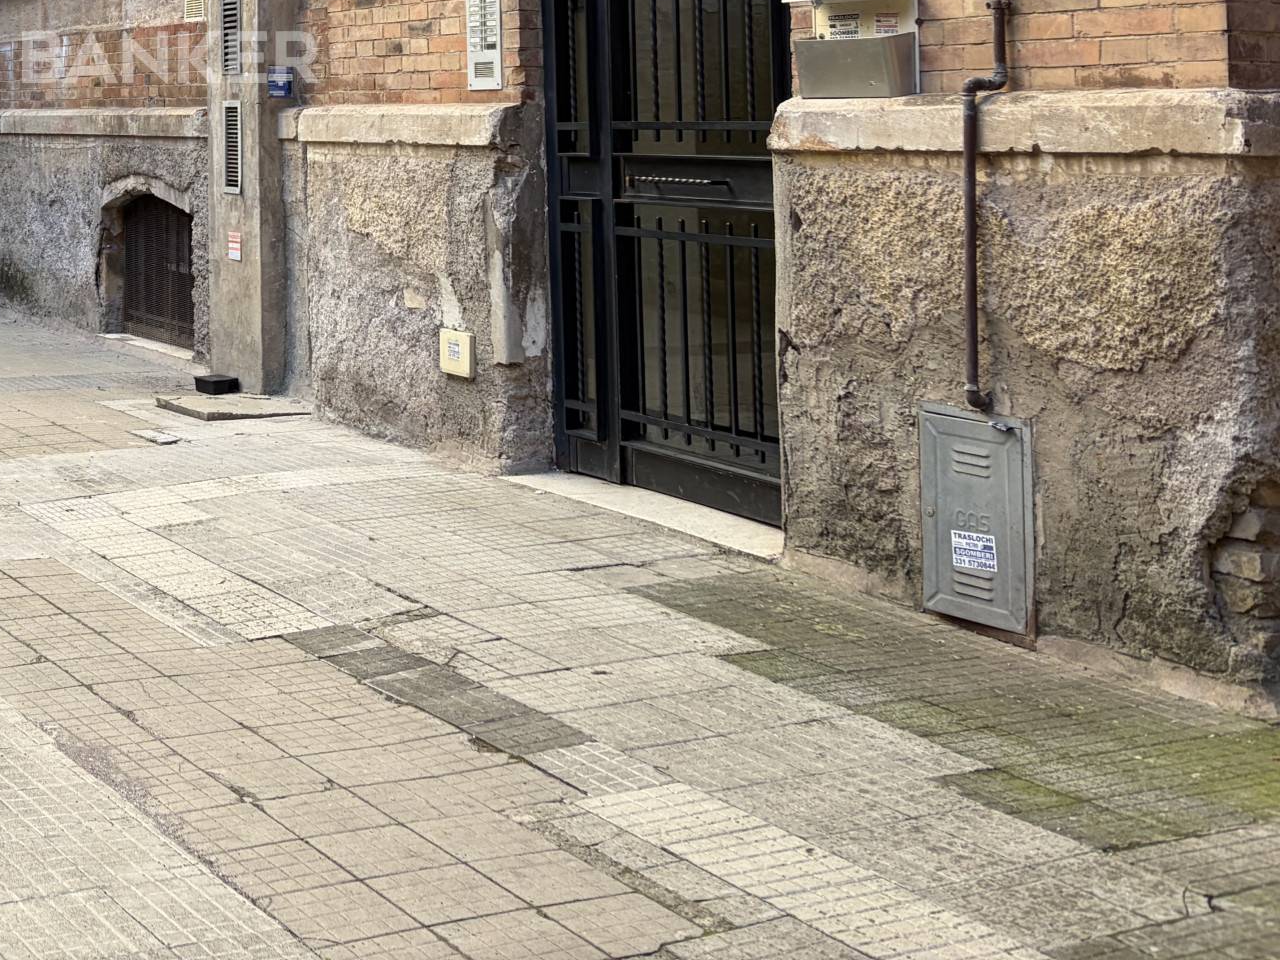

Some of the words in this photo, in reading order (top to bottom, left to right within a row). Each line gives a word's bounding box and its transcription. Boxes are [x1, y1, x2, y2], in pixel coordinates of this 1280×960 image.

[956, 509, 991, 532] GAS
[953, 532, 993, 544] TRASLOCHI
[955, 548, 993, 559] SGOMBERI
